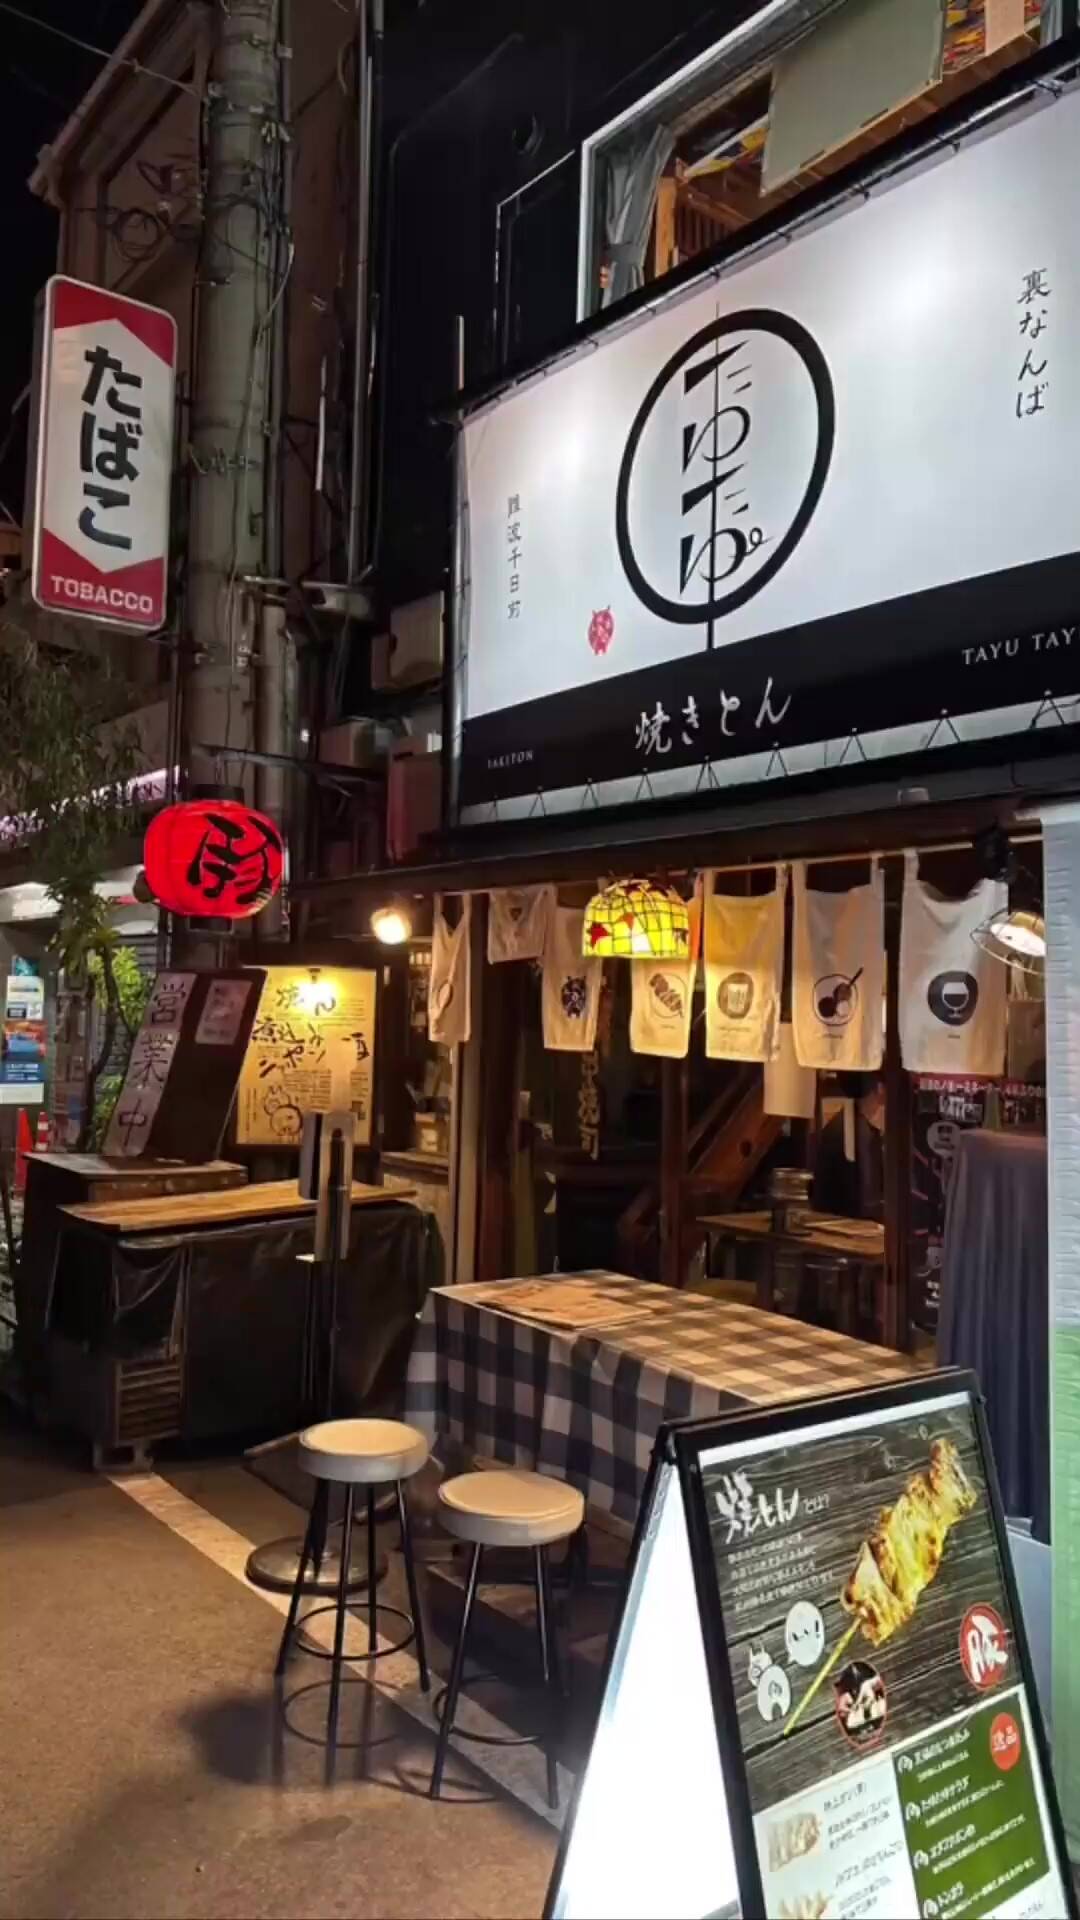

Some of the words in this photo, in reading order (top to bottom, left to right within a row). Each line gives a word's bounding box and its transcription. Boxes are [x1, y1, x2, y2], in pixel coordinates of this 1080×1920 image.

[1015, 267, 1052, 419] 裏なんば
[78, 345, 143, 551] たばこ
[50, 574, 154, 614] TOBACCO
[961, 637, 1020, 665] TAYU
[633, 676, 792, 755] 焼きとん
[119, 982, 187, 1149] 営業中
